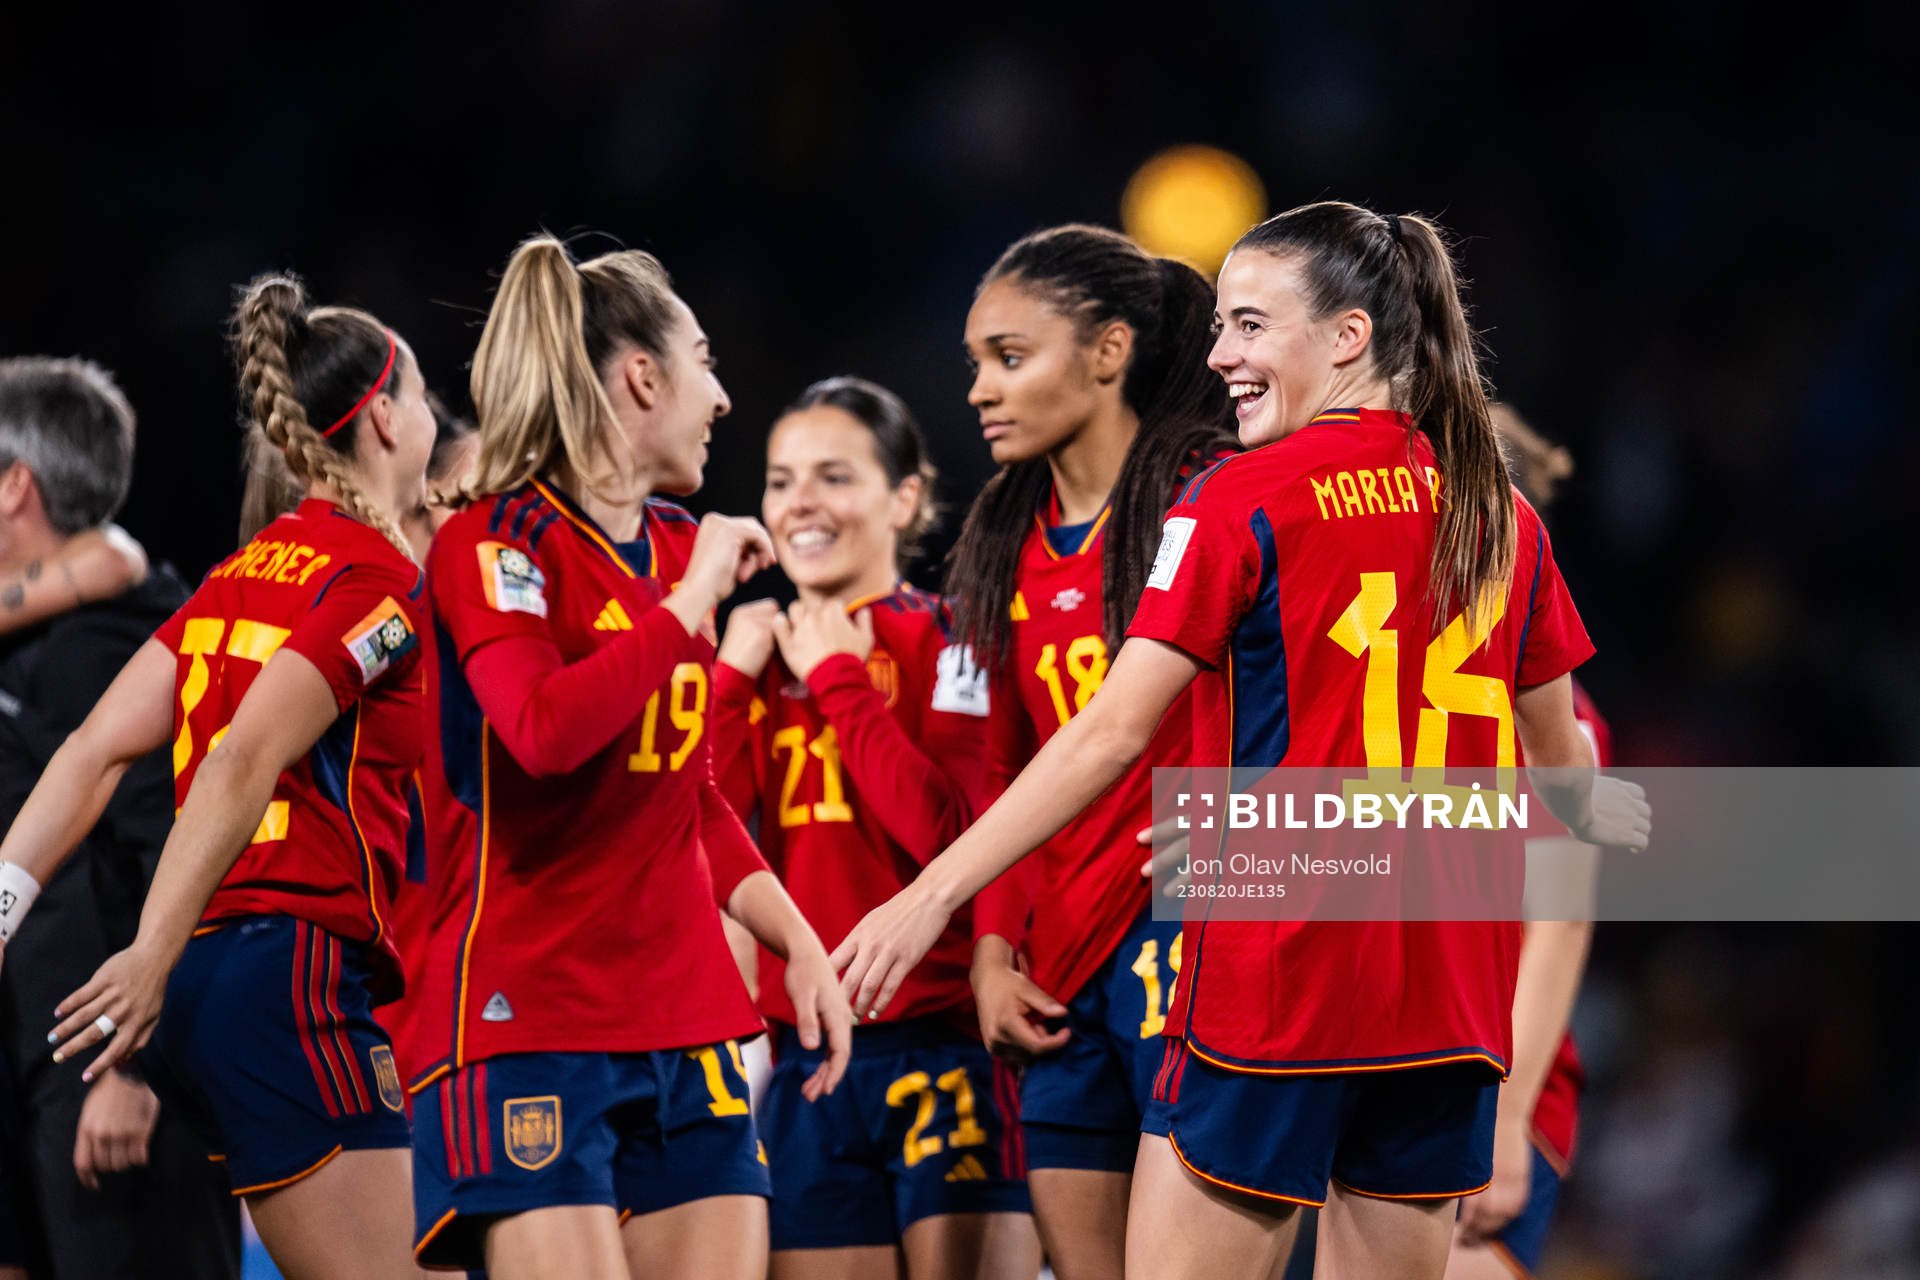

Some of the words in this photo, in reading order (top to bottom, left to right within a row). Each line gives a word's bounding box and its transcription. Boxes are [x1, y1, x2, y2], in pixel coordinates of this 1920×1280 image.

[1309, 465, 1420, 521] MARIA
[627, 663, 708, 773] 19
[1034, 634, 1110, 731] 18
[1326, 571, 1518, 831] 16
[771, 724, 854, 828] 21
[885, 1067, 987, 1168] 21
